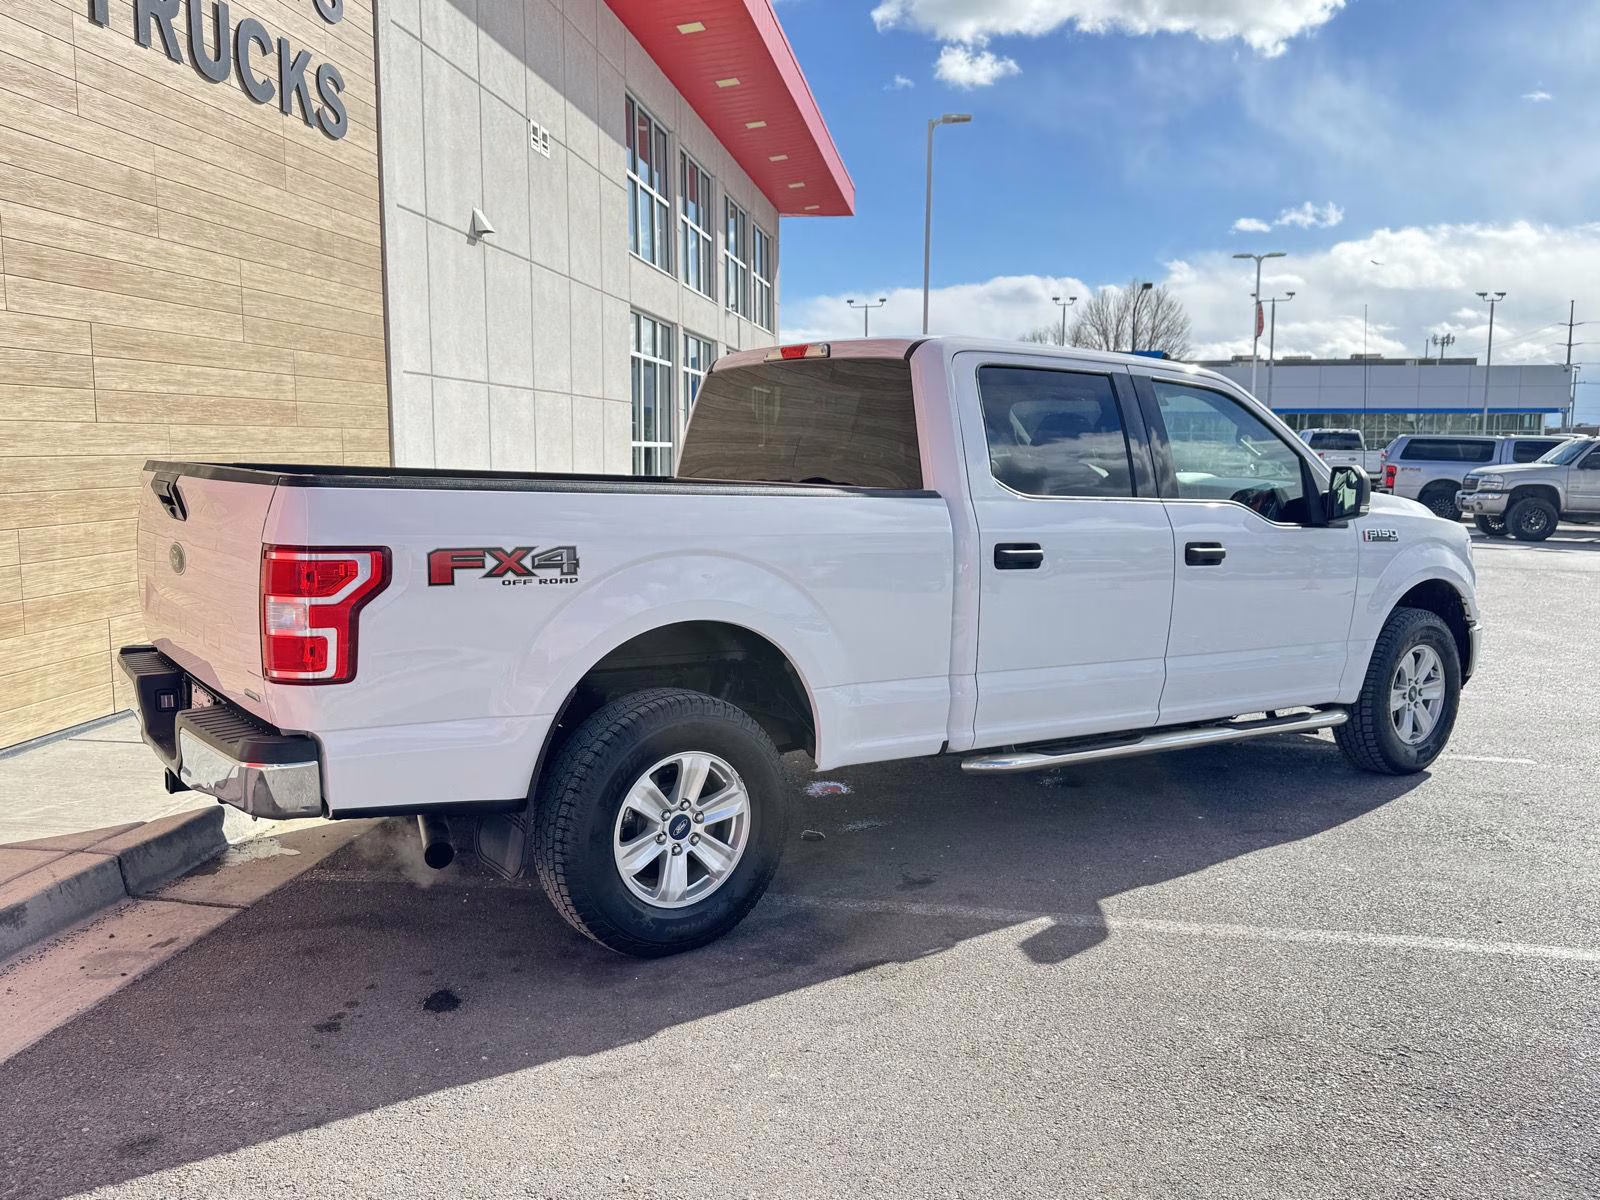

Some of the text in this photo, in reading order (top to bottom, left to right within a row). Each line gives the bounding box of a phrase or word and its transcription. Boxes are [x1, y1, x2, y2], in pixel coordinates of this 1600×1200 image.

[427, 545, 580, 586] FX4
[501, 577, 579, 587] OFF ROAD
